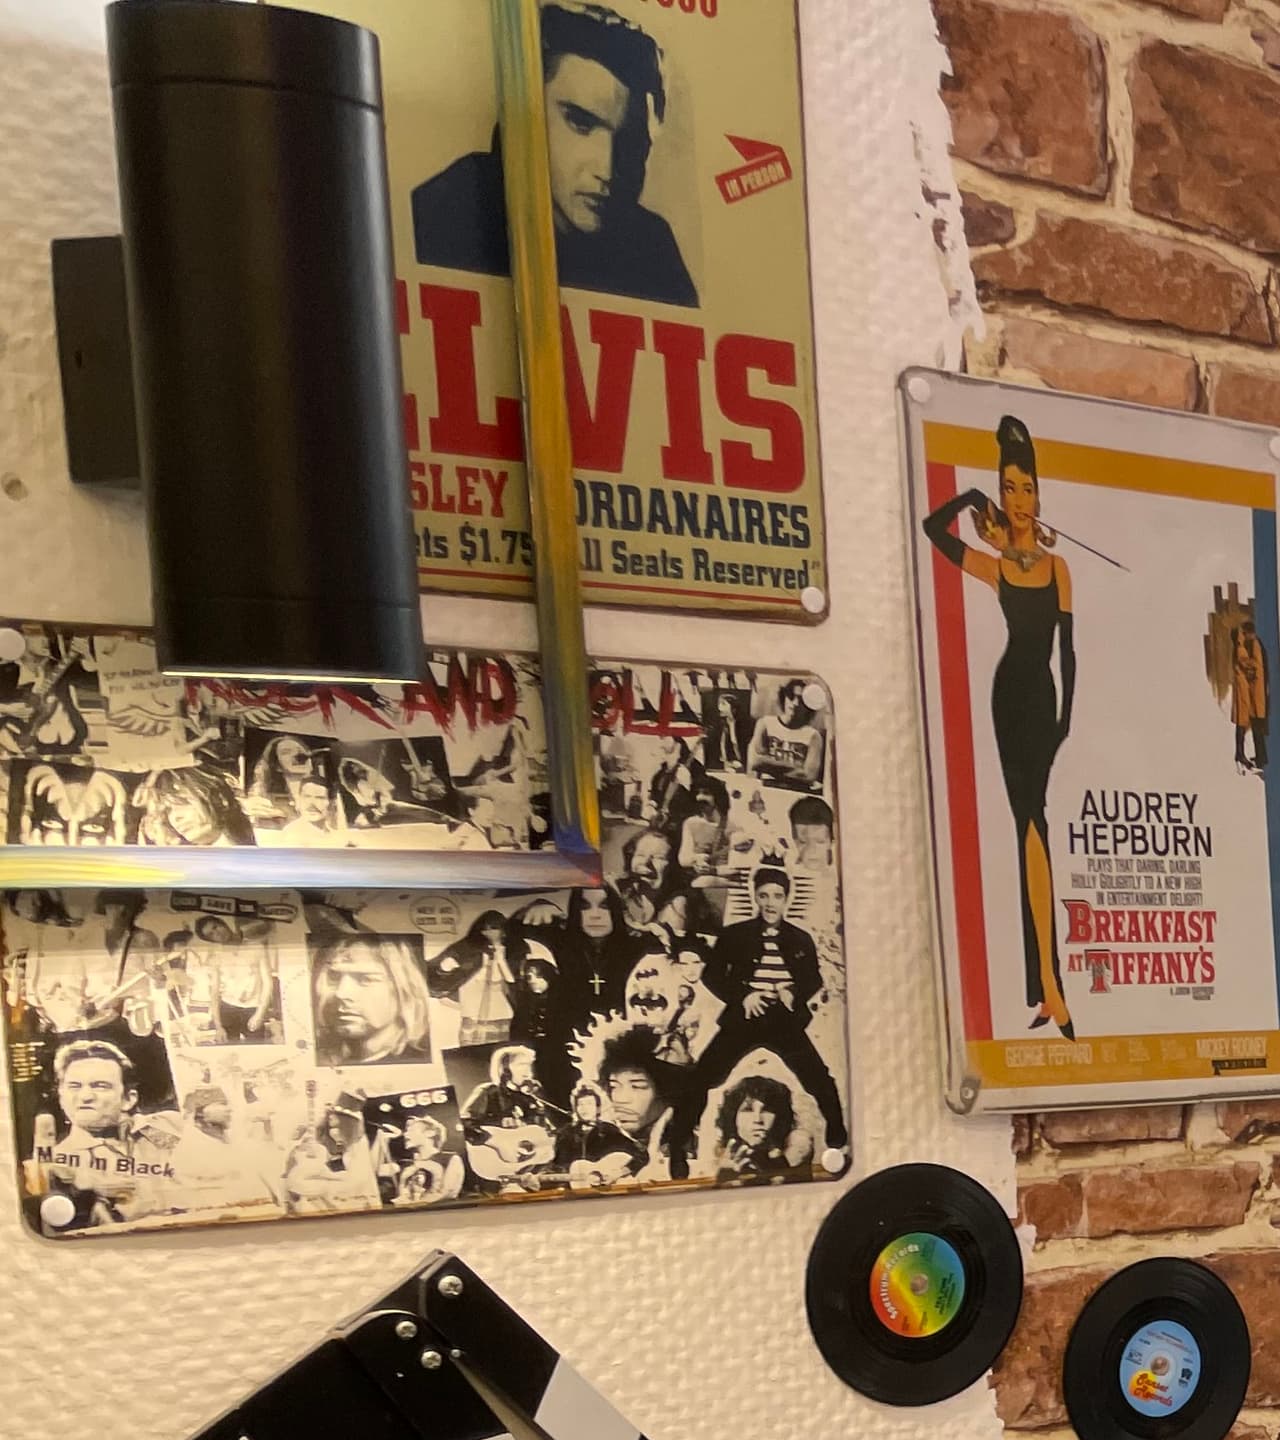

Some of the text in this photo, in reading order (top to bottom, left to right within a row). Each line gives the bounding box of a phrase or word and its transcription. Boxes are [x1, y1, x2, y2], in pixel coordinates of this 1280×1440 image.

[396, 279, 807, 495] LVIS
[573, 479, 811, 549] ORDANAIRES
[611, 539, 684, 580] Seats
[692, 548, 810, 590] Reserved
[1080, 789, 1199, 825] AUDREY
[1068, 822, 1213, 858] HEPBURN
[1115, 858, 1134, 874] THAT
[1060, 899, 1218, 944] BREAKFAST
[1067, 953, 1084, 972] AT
[37, 1144, 81, 1169] Man
[116, 1157, 176, 1180] Black
